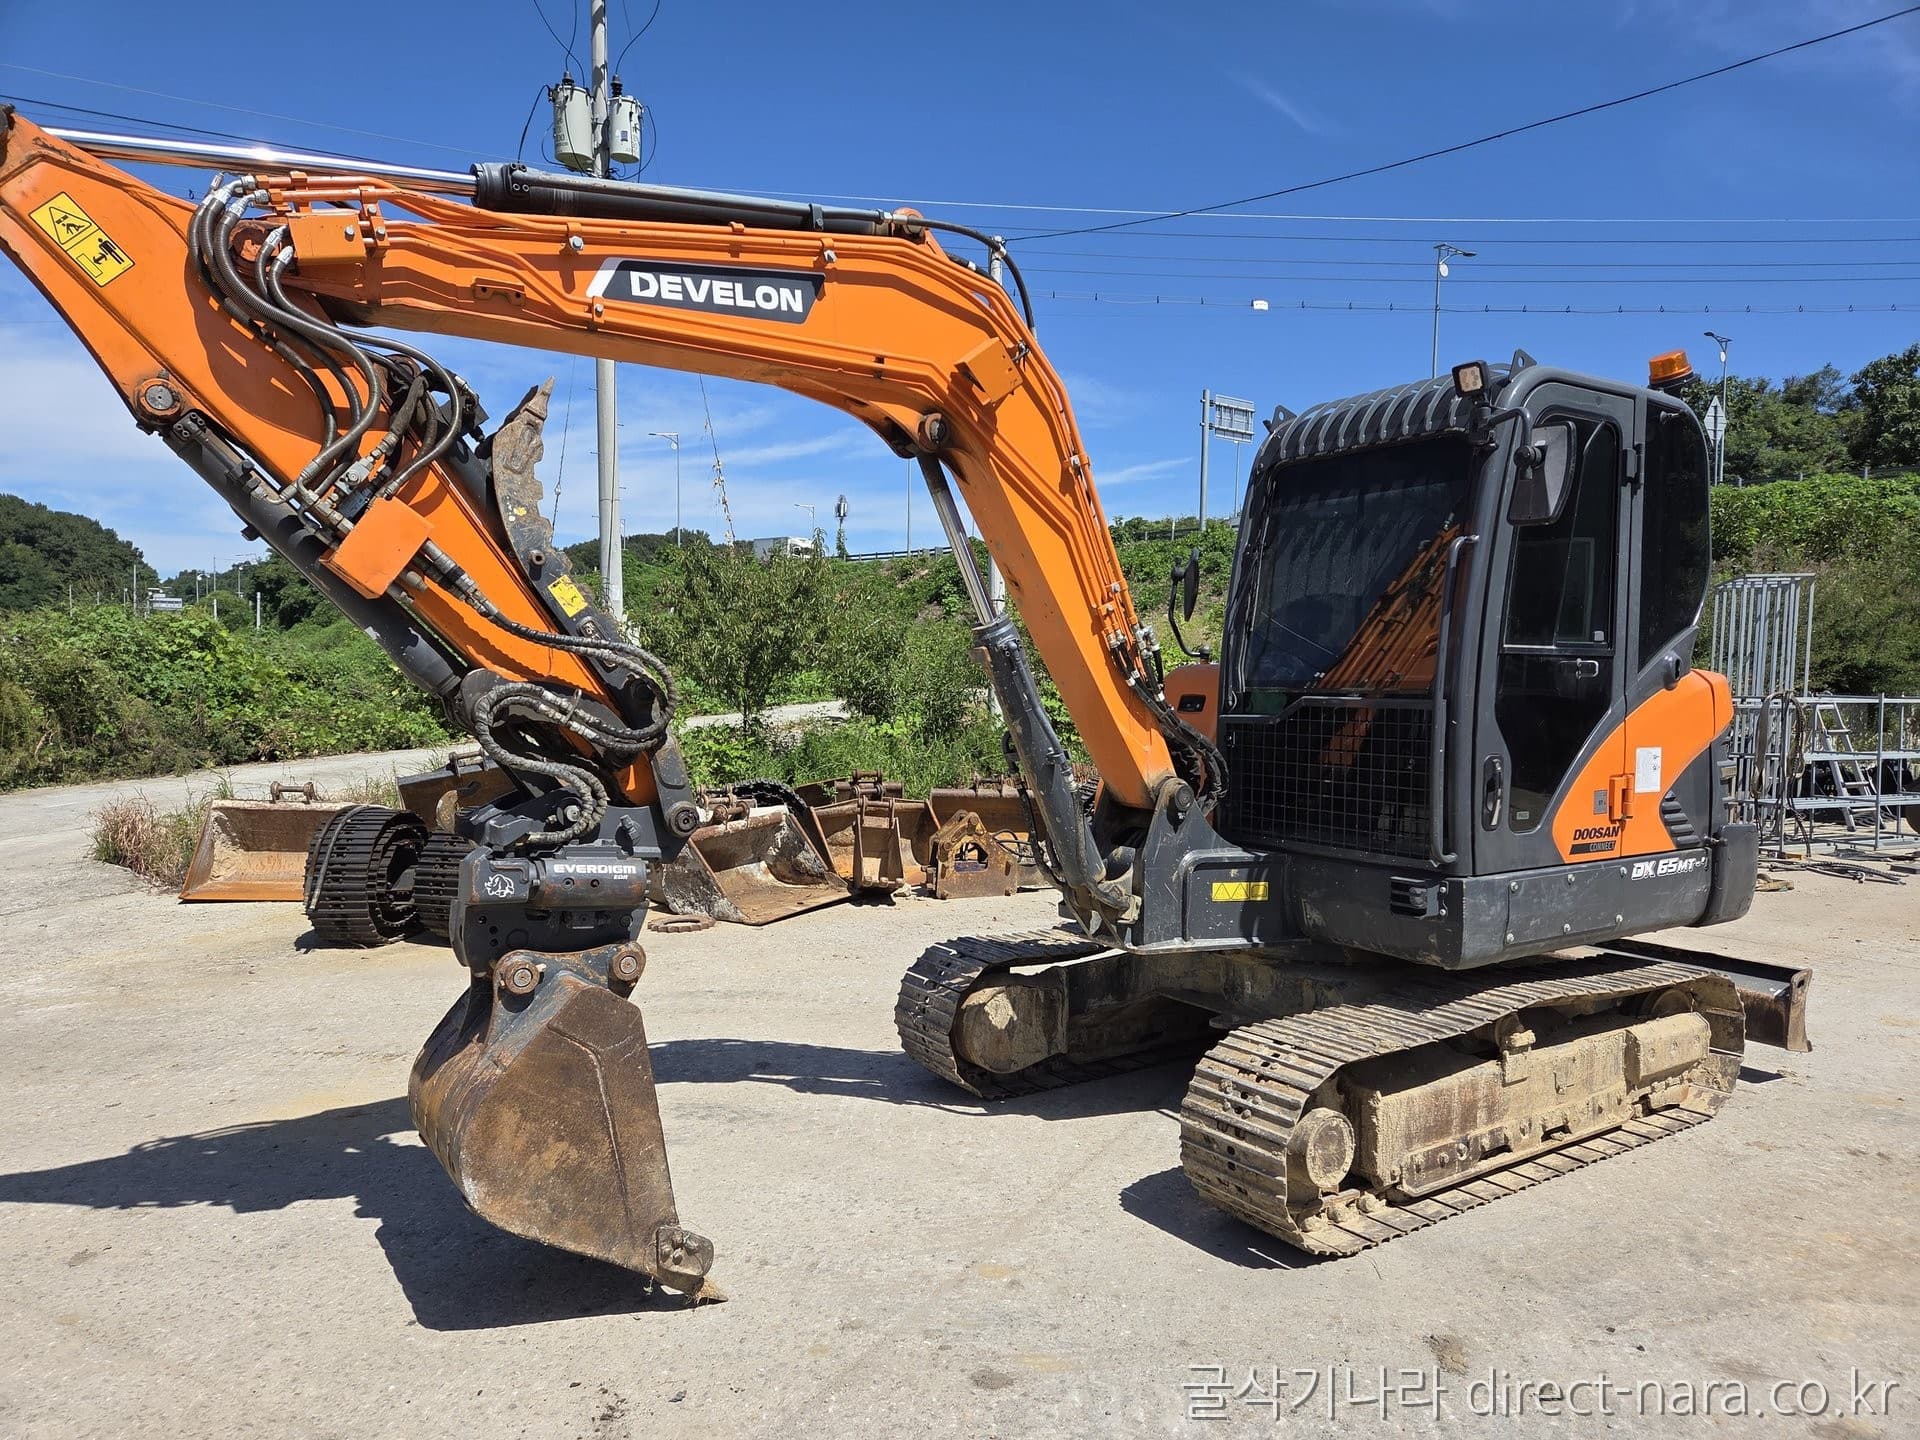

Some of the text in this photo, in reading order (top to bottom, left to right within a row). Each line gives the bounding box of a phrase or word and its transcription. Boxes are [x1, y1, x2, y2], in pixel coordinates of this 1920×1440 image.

[630, 270, 803, 313] DEVELON
[1573, 825, 1620, 841] DOOSAN
[554, 864, 636, 874] EVERDIGM
[1631, 860, 1657, 881] DX
